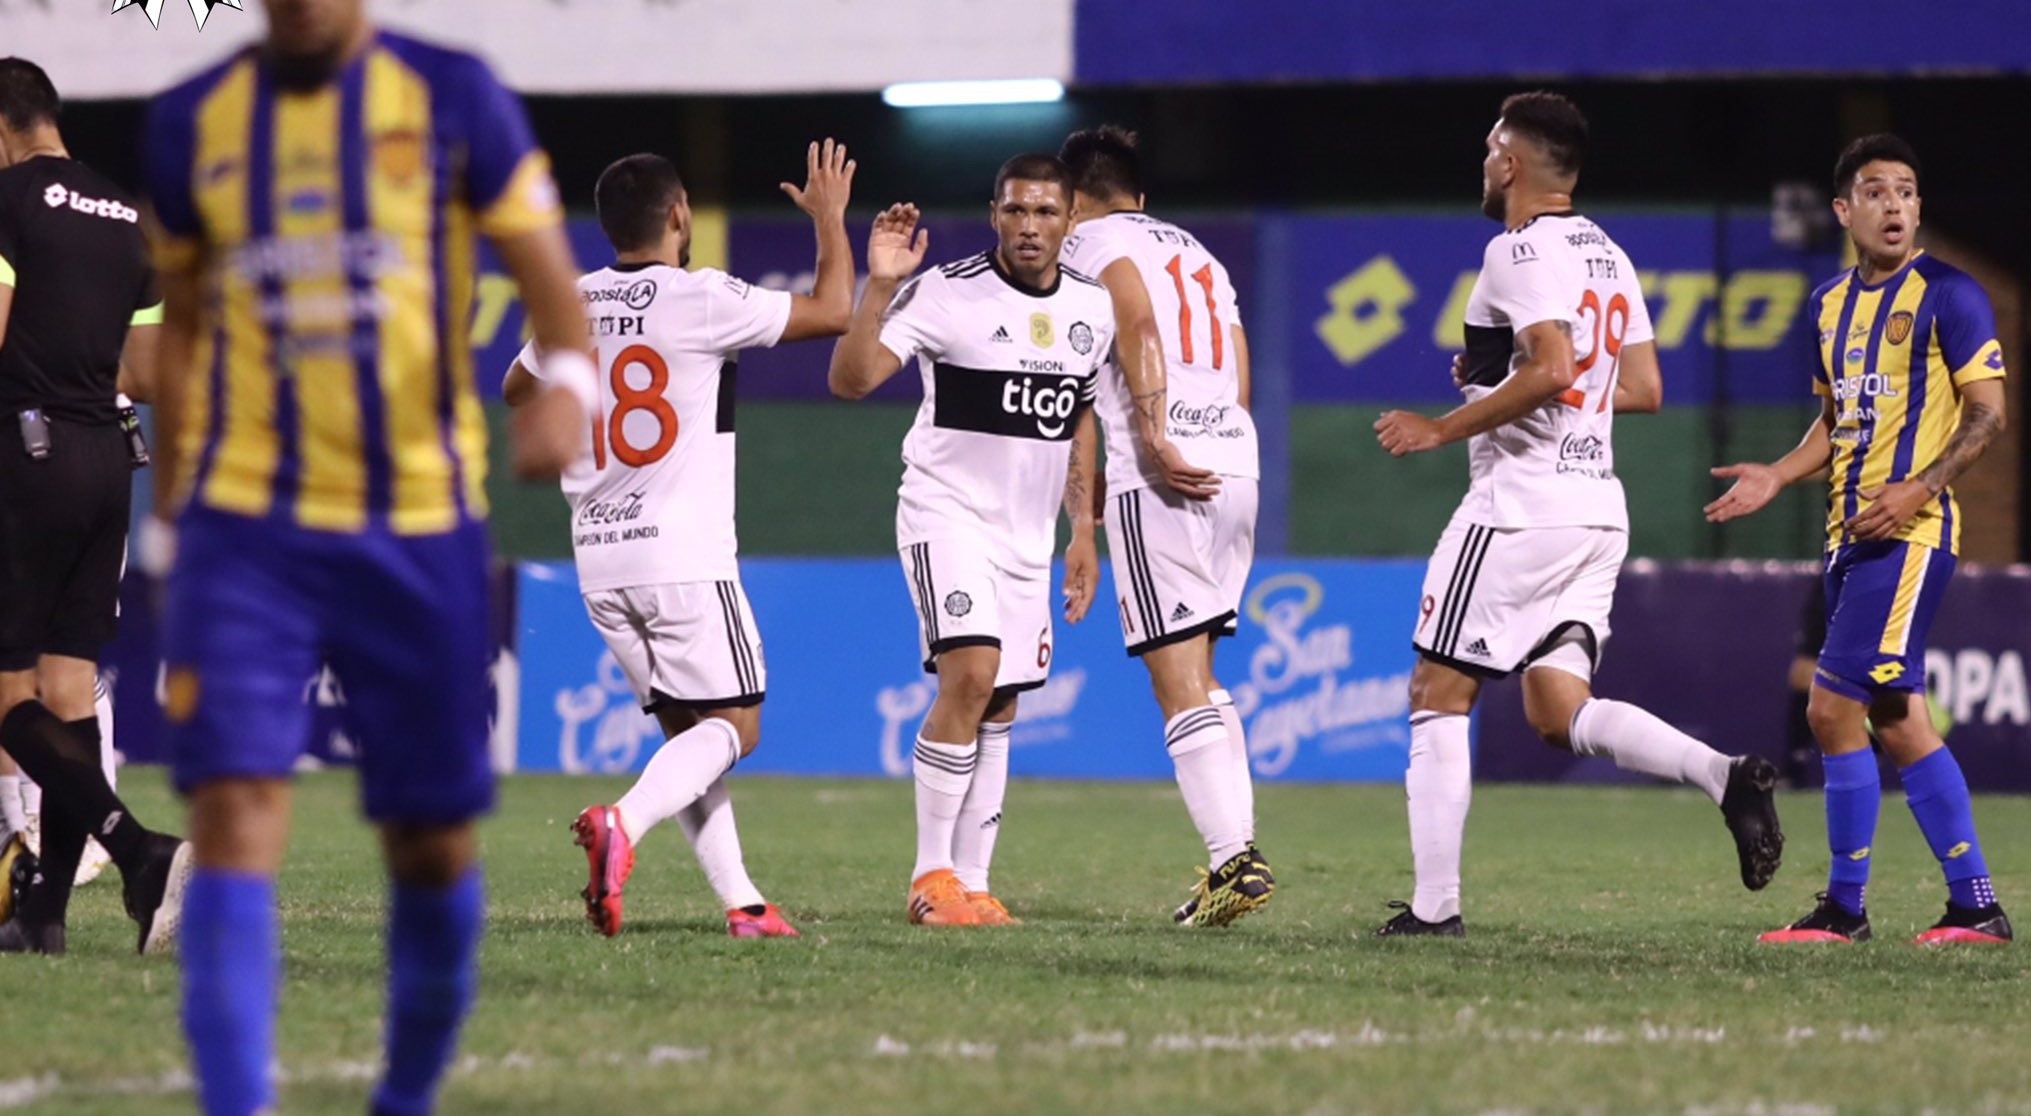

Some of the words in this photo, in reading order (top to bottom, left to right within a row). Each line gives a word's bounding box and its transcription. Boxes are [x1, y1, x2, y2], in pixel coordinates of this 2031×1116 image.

[69, 190, 138, 223] lotto
[1165, 253, 1223, 371] 11
[1553, 289, 1629, 414] 29
[592, 343, 679, 471] 18
[1832, 373, 1898, 401] RISTOL
[622, 526, 659, 542] MUNDO
[1419, 594, 1435, 634] 9
[1037, 620, 1050, 668] 6
[1925, 648, 2030, 727] OPA
